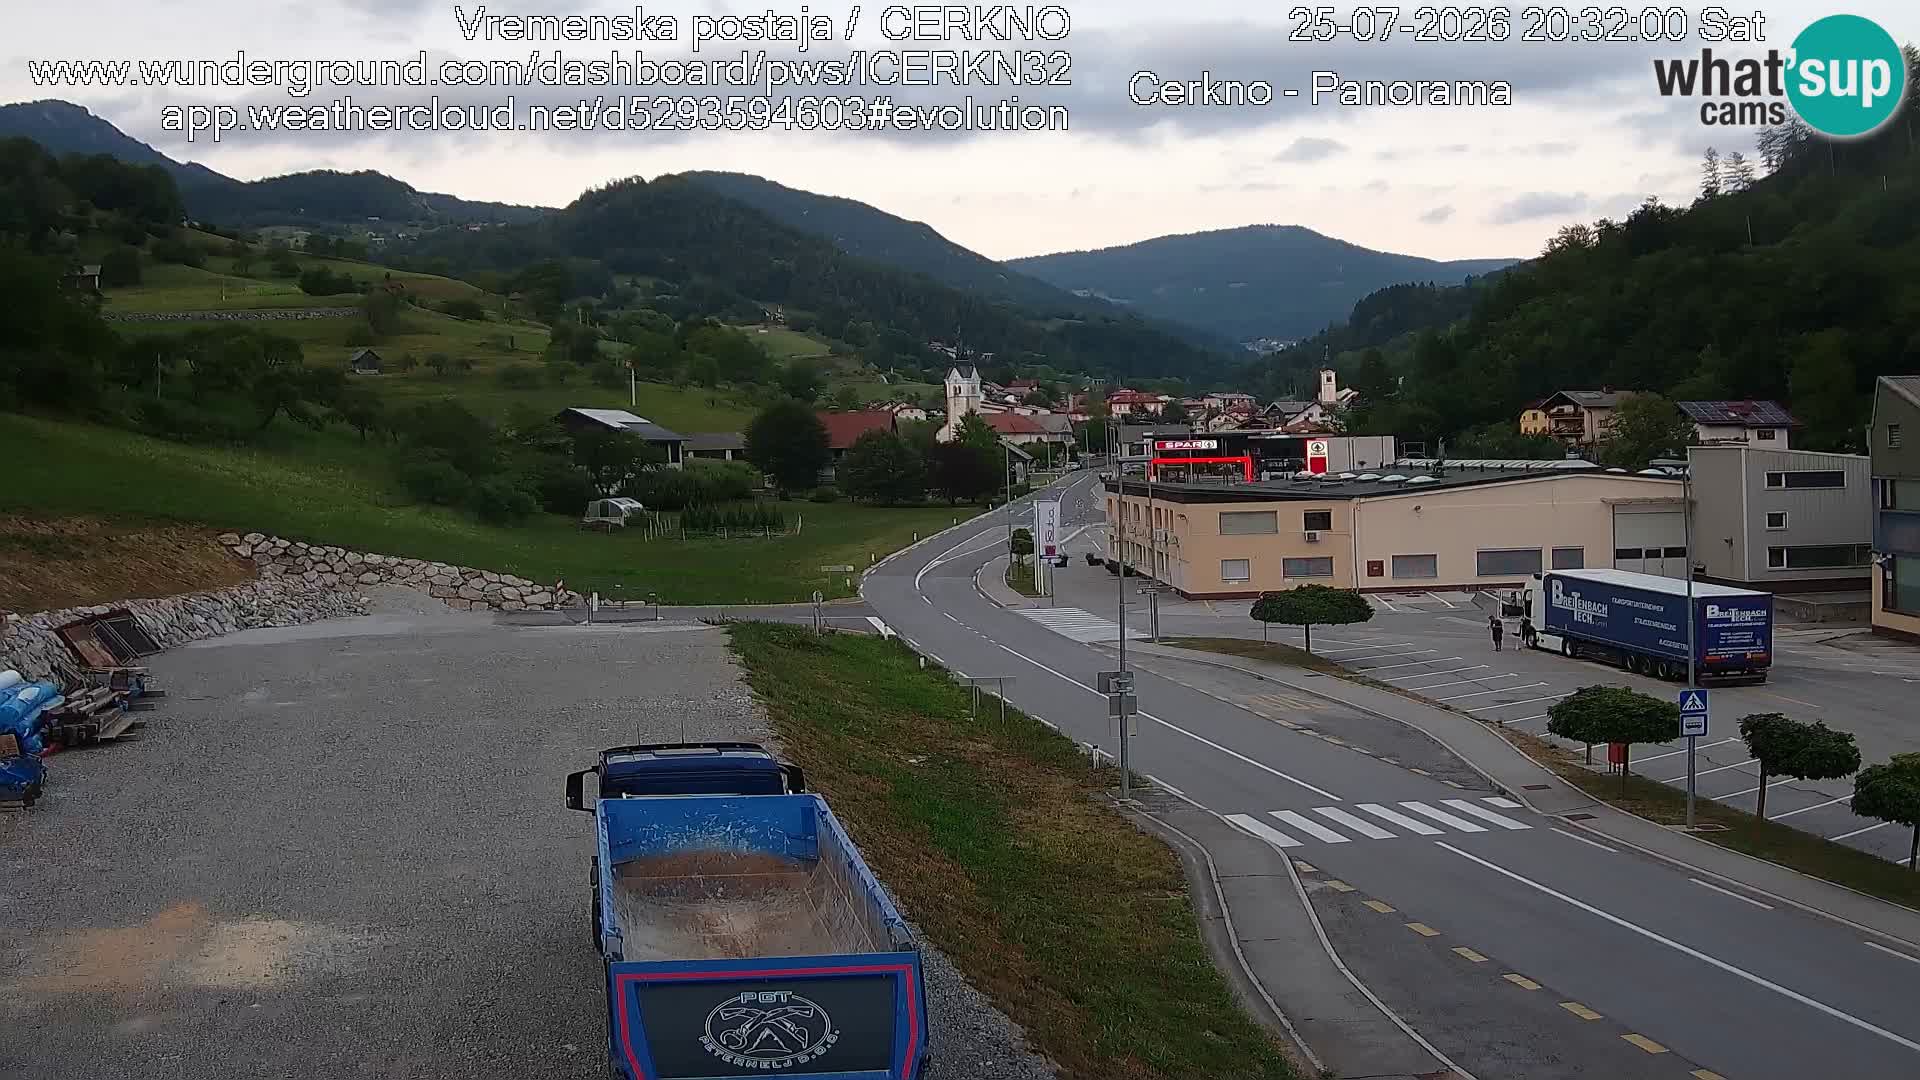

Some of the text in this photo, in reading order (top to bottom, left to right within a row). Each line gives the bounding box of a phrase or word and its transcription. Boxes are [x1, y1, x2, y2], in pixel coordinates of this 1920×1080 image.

[1165, 441, 1202, 449] SPAR
[740, 991, 793, 1004] PGT
[698, 1035, 793, 1069] PETERNELJ
